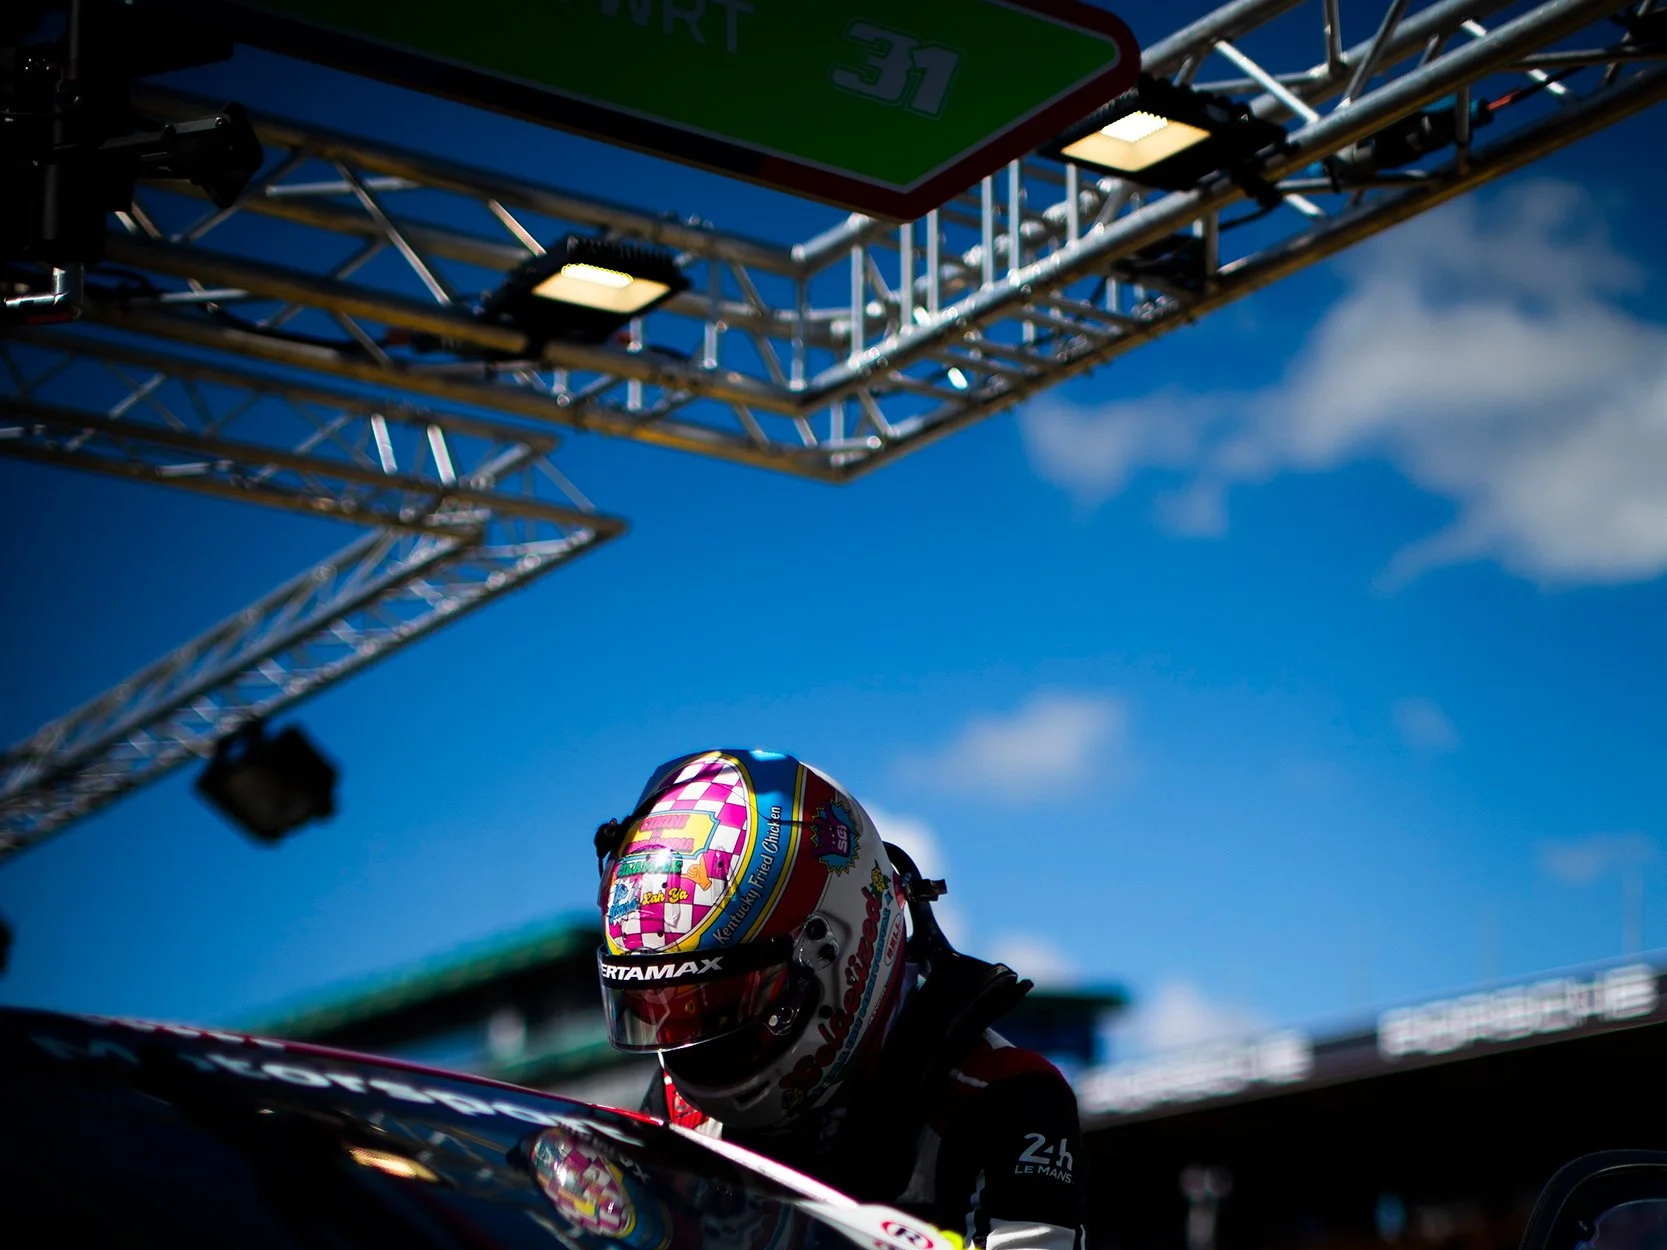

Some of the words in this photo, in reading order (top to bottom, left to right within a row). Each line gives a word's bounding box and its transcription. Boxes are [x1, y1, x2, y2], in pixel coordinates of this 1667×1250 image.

[827, 15, 967, 120] 31
[713, 888, 763, 946] Kentucky
[748, 854, 774, 889] Fried
[762, 806, 781, 854] Chicken
[1014, 1164, 1035, 1175] LE
[1037, 1165, 1073, 1184] MANS
